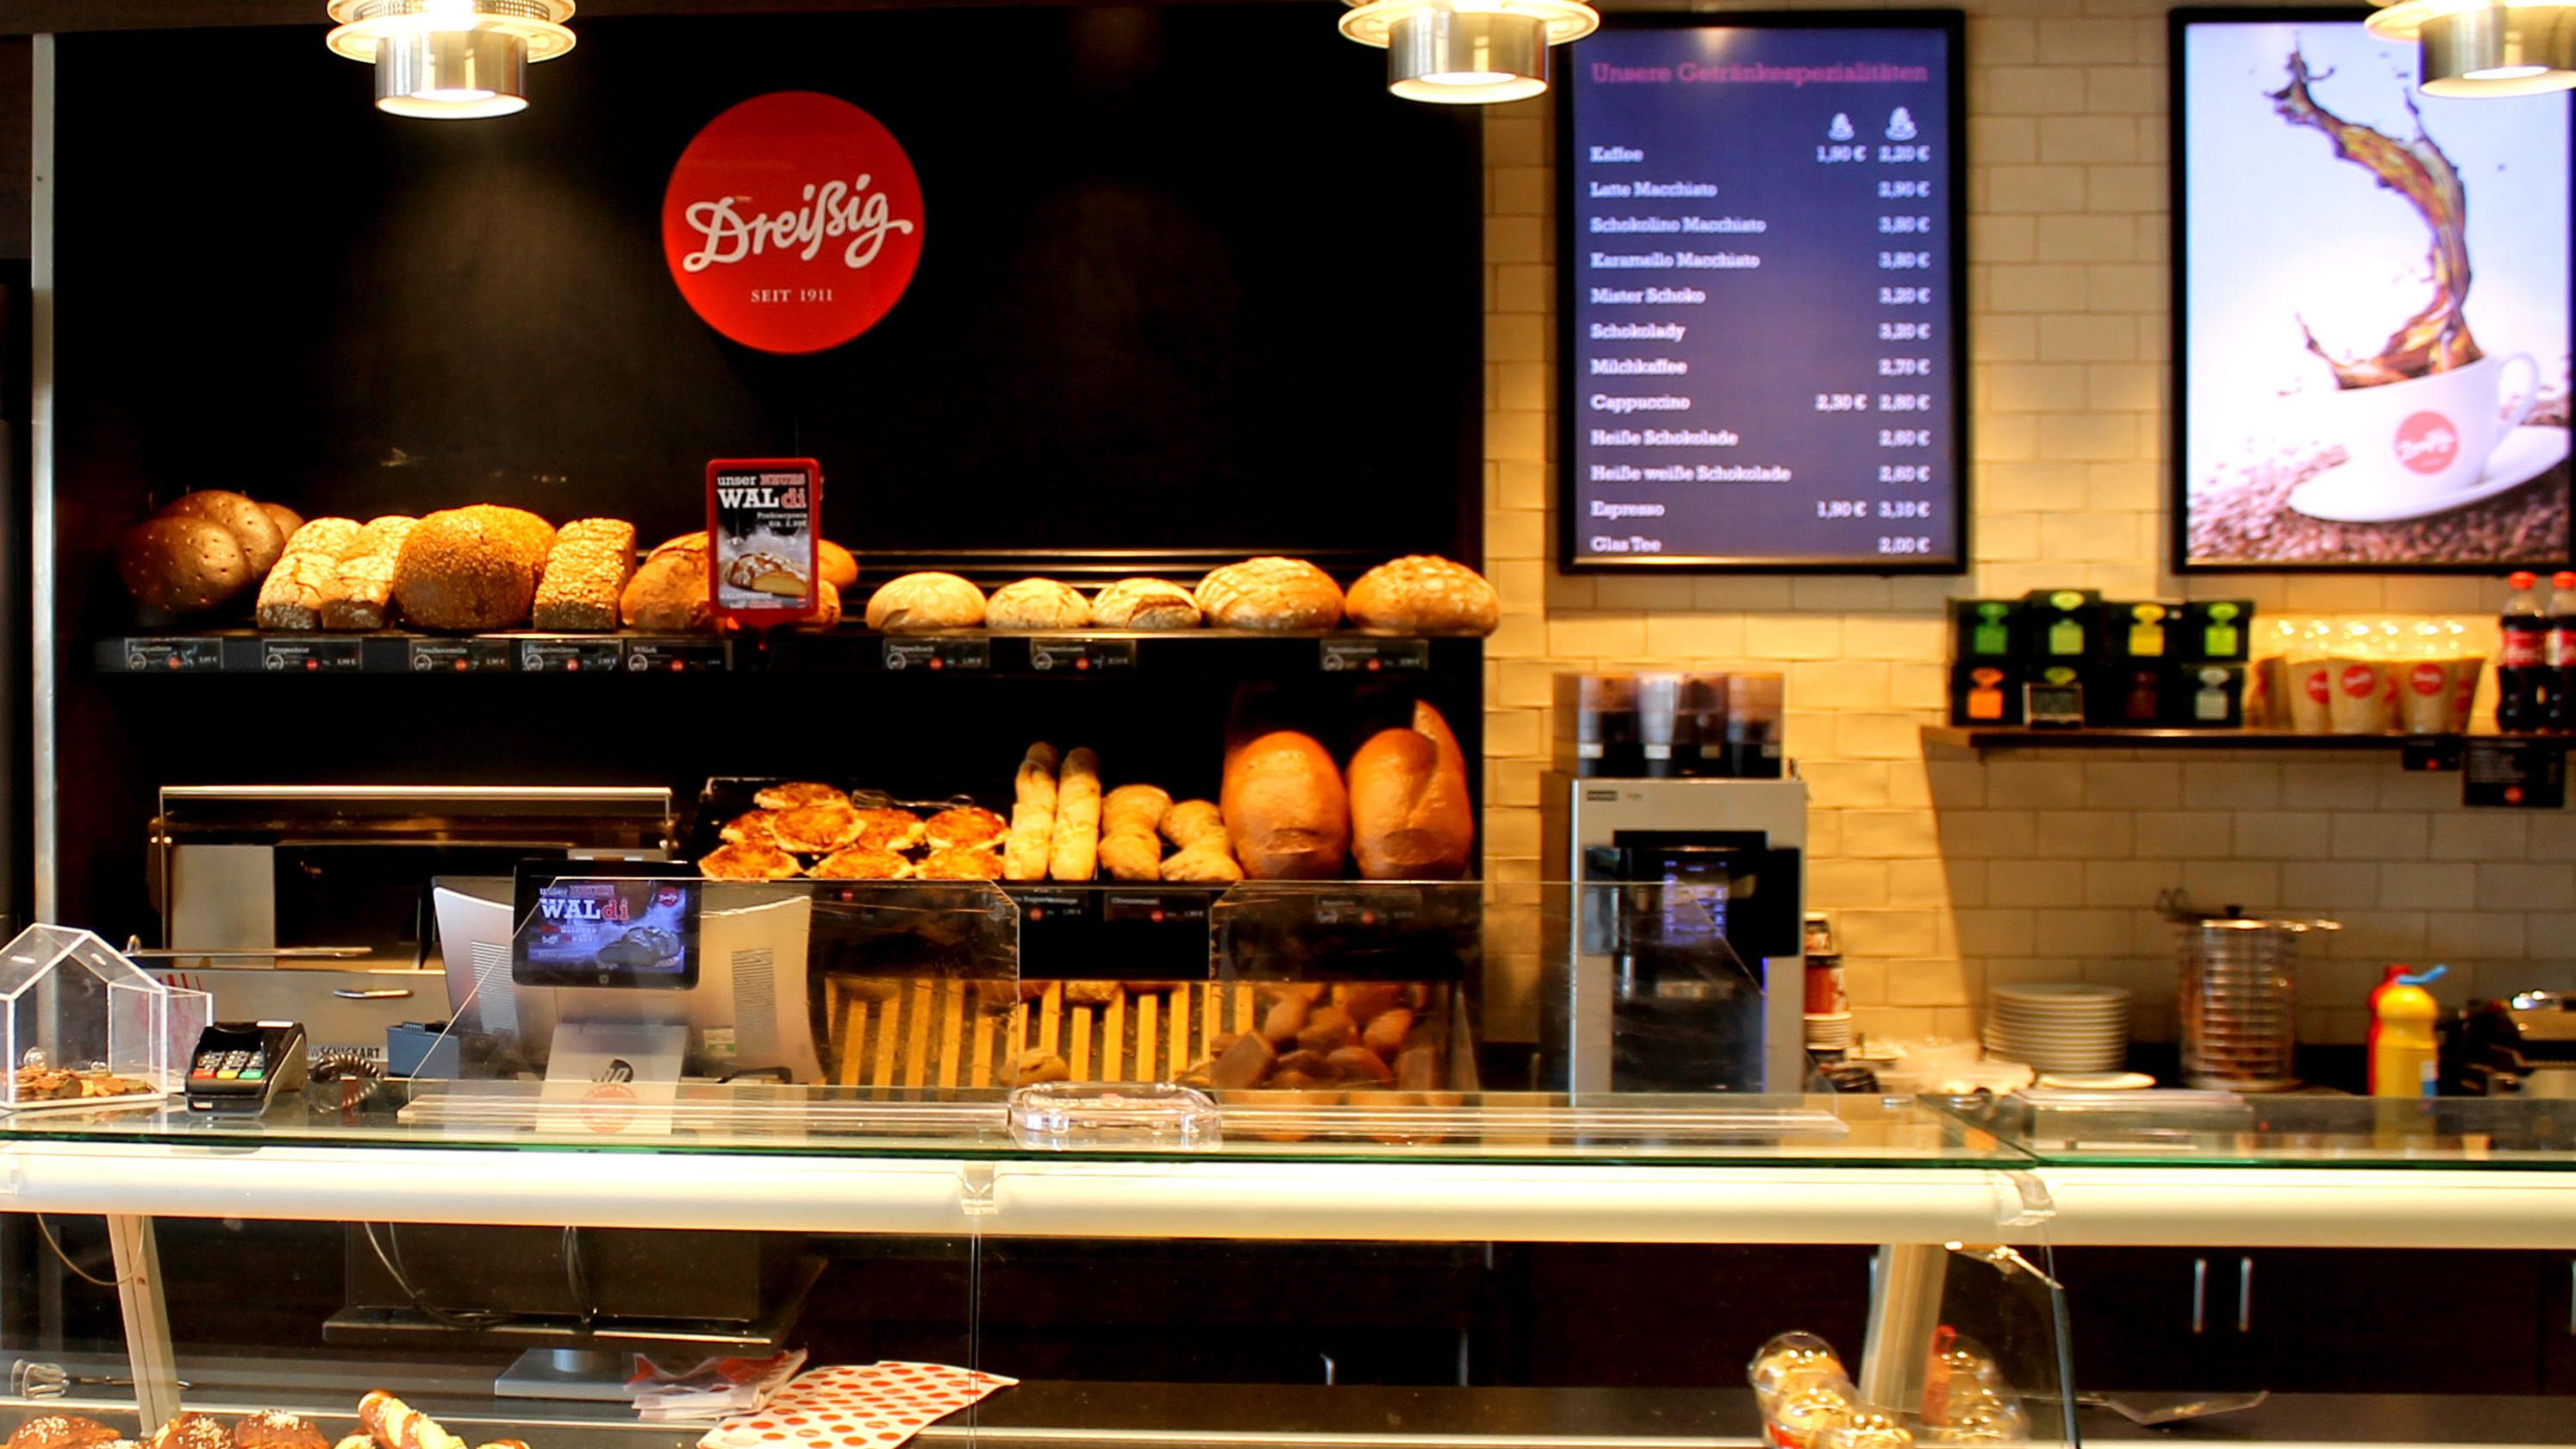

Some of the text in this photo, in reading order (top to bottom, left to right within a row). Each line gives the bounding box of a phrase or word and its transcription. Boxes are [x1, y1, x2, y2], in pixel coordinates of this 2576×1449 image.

[1590, 61, 1929, 86] Unsere Getränkespezialitäten
[1590, 147, 1644, 162] Kaffee
[1590, 181, 1631, 197] Latte
[1633, 181, 1718, 197] Macchiato
[683, 174, 914, 272] Dreißig
[1590, 216, 1681, 233] Schokolino
[1682, 216, 1767, 233] Macchiato
[1590, 252, 1675, 268] Karamello
[1676, 252, 1760, 268] Macchiato
[751, 289, 833, 303] SEIT 1911
[1590, 287, 1644, 303] Mister
[1645, 287, 1706, 303] Schoko
[1590, 322, 1687, 342] Schokolady
[1591, 358, 1687, 374] Milchkaffee
[1590, 394, 1691, 413] Cappuccino
[1591, 429, 1641, 446] Heiße
[1644, 429, 1738, 446] Schokolade
[717, 476, 757, 486] unser
[1591, 465, 1641, 481] Heiße
[1643, 465, 1694, 481] weiße
[1696, 465, 1792, 481] Schokolade
[1591, 500, 1665, 520] Espresso
[1590, 536, 1629, 552] Glas
[1630, 536, 1662, 552] Tee
